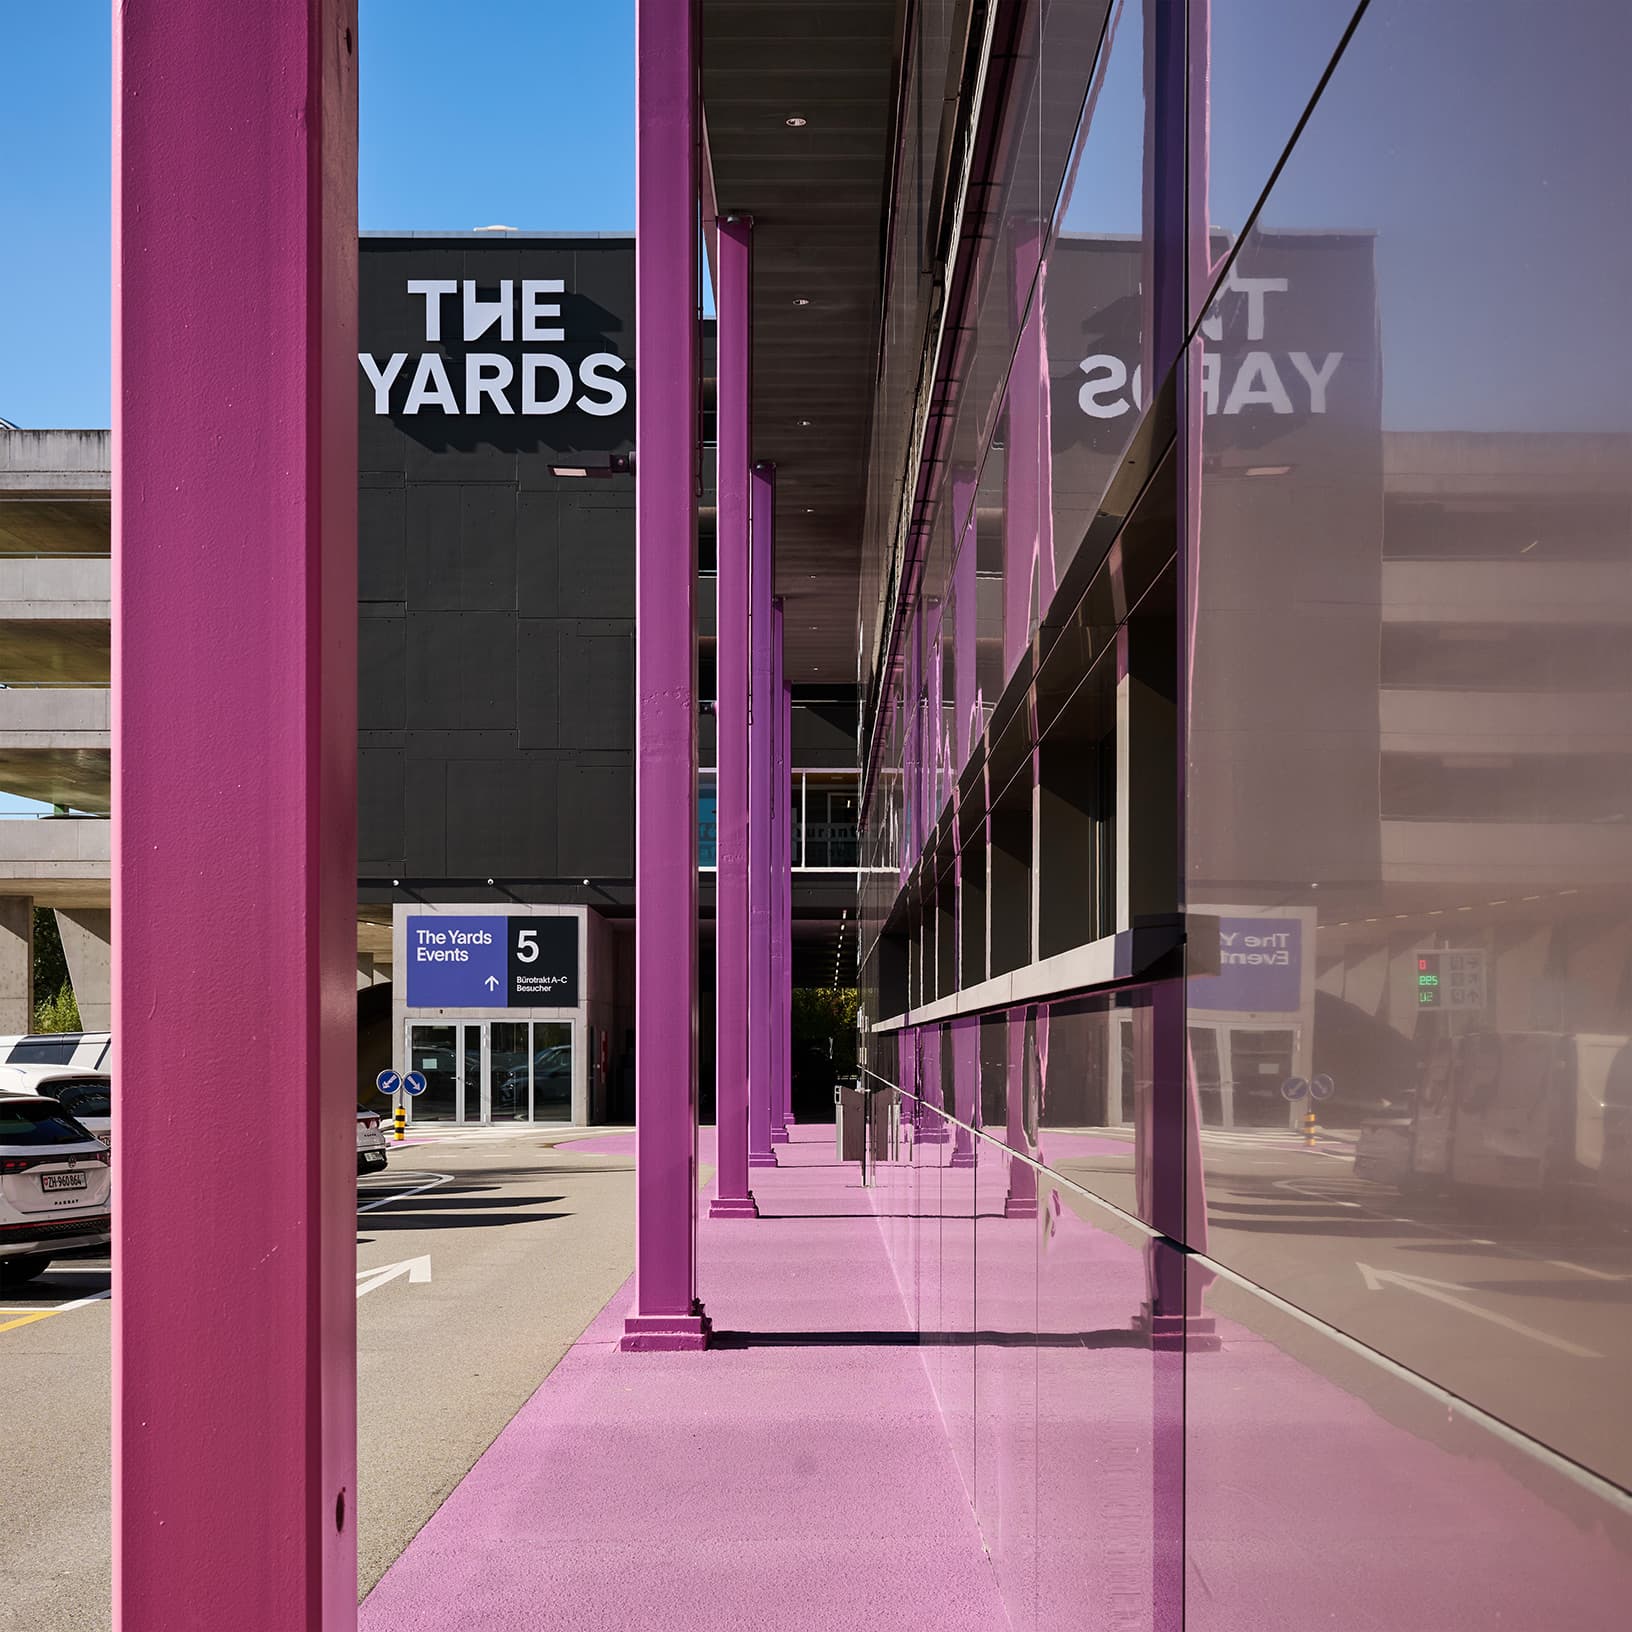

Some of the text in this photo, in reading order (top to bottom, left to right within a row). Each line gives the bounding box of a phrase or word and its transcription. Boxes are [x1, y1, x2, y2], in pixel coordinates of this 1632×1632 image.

[407, 280, 565, 341] THE
[358, 352, 627, 416] YARDS
[416, 929, 493, 945] The Yards
[416, 946, 469, 962] Events
[516, 930, 540, 963] 5
[516, 975, 568, 984] Bürotrakt A-C
[516, 984, 552, 992] Besucher
